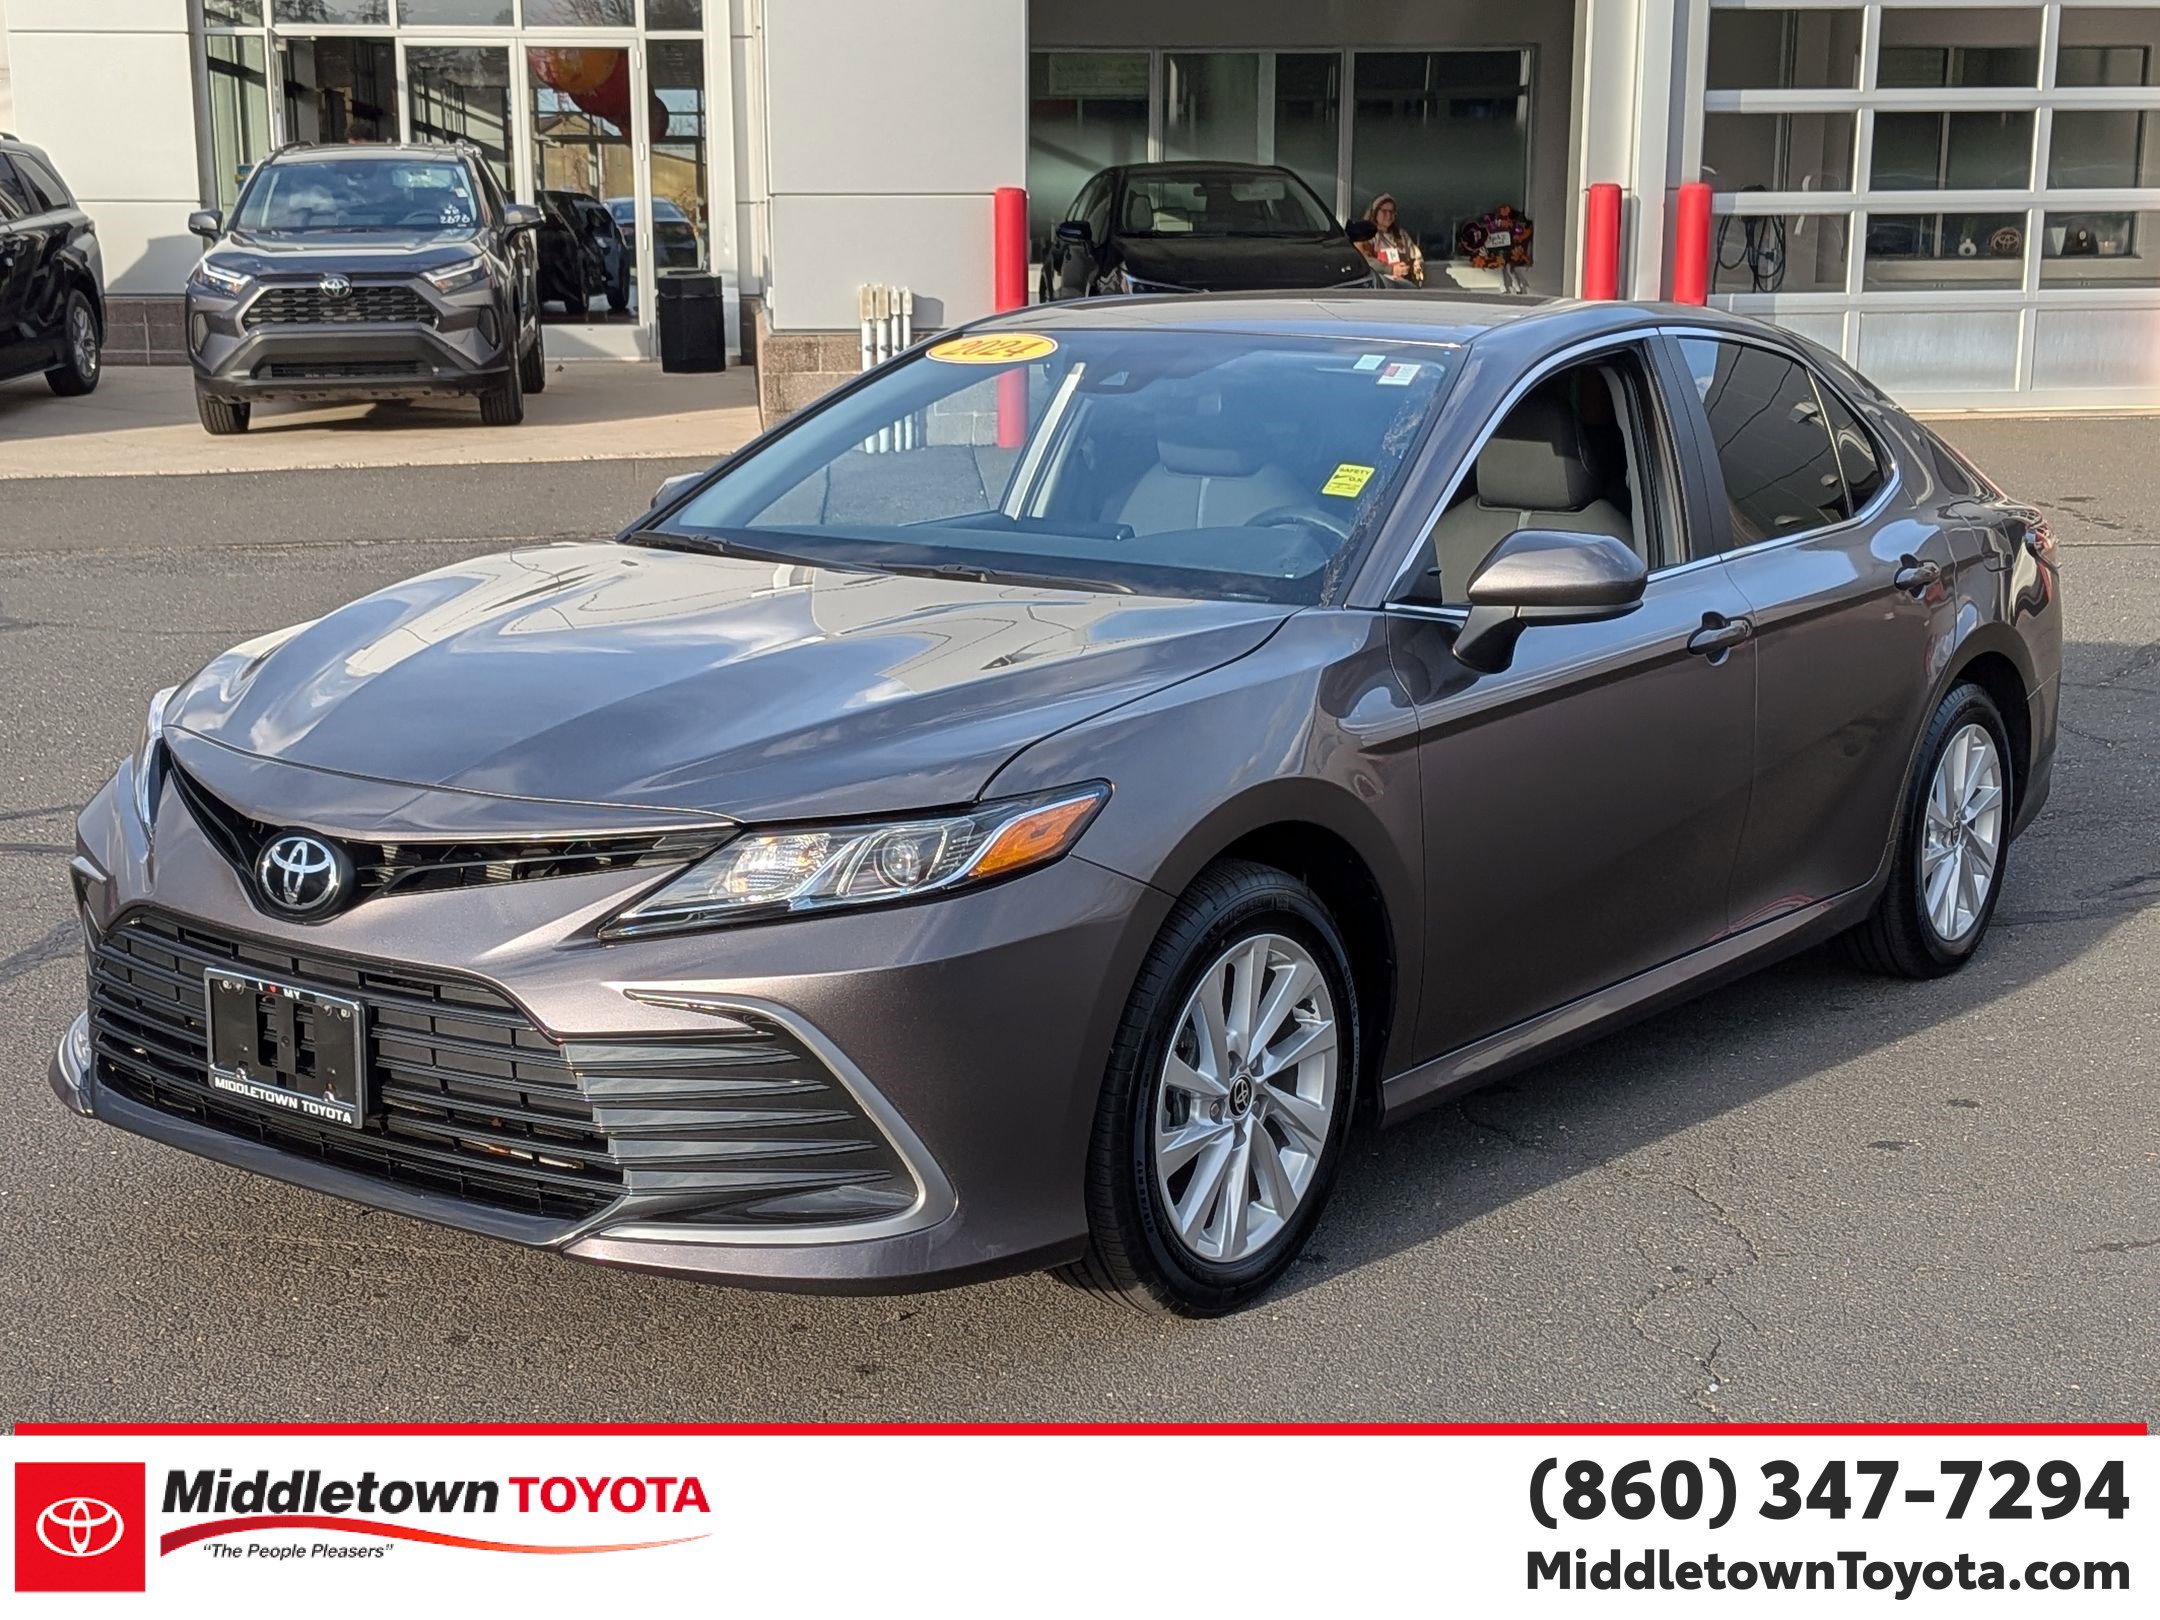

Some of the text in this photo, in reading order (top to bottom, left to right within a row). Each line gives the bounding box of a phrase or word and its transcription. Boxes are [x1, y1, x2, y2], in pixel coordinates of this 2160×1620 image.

[940, 340, 1044, 357] 2024
[283, 988, 300, 1000] MY
[215, 1076, 352, 1124] MIDDLETOWN TOYOTA
